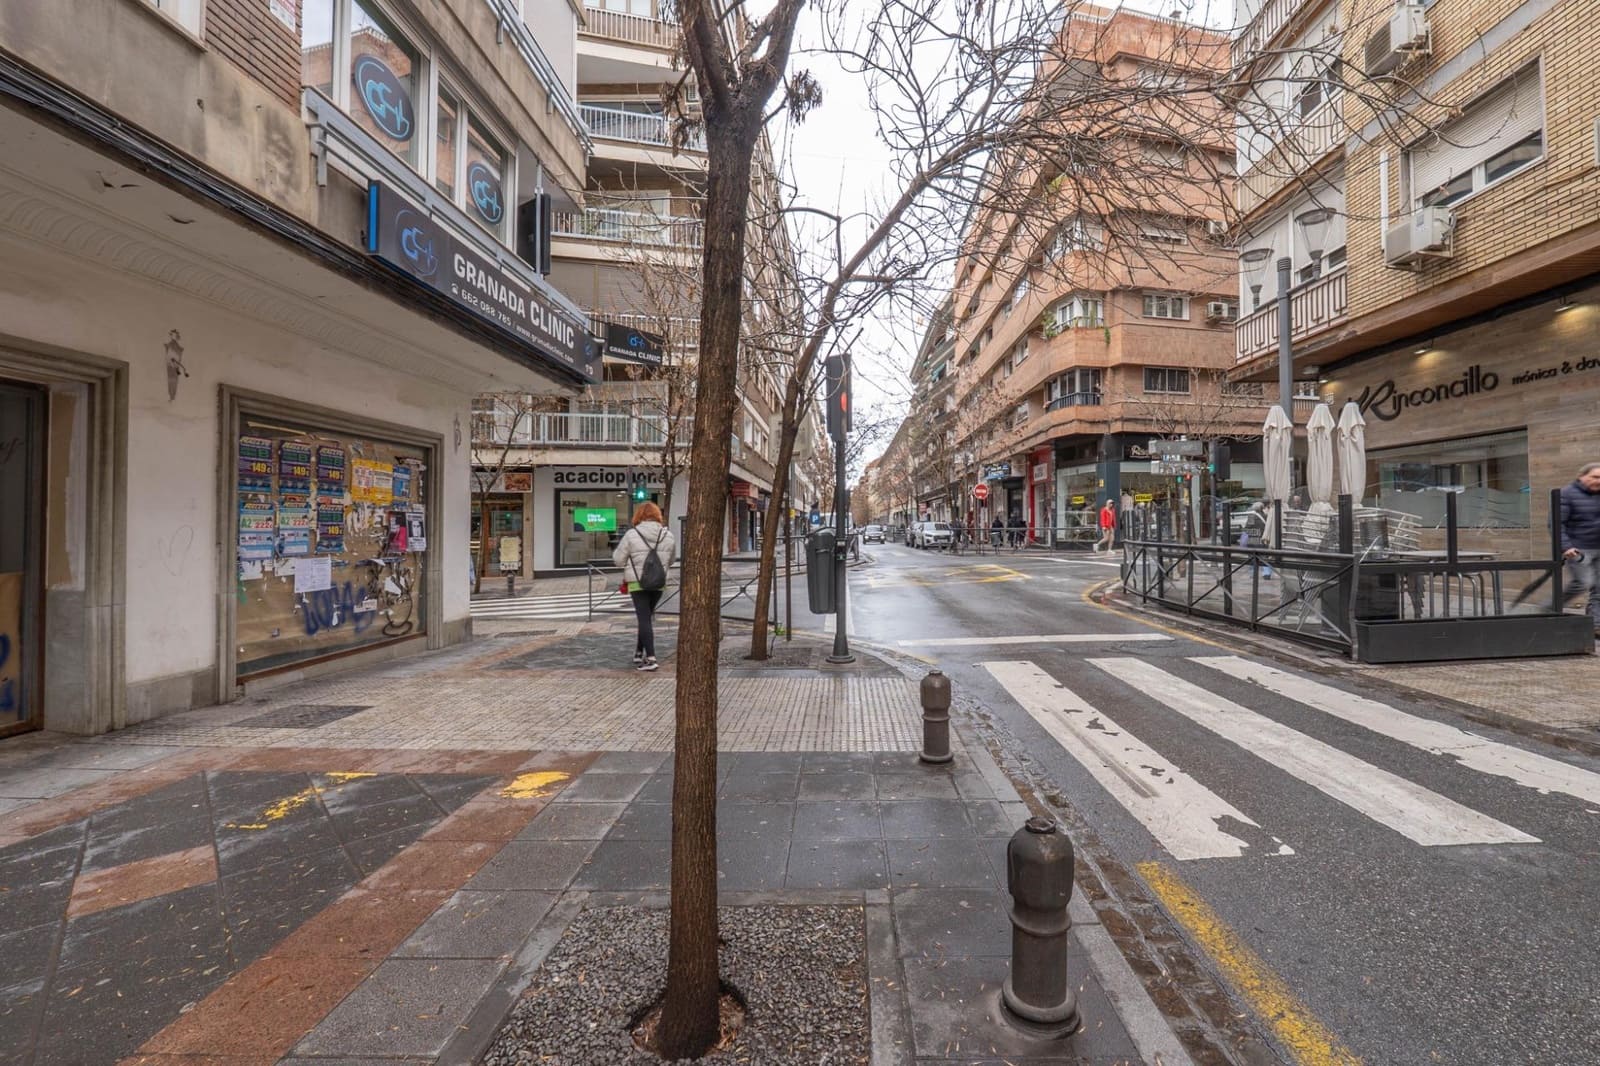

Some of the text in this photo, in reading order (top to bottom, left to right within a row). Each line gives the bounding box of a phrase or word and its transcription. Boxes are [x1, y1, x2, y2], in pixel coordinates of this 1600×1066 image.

[454, 253, 575, 349] GRANADA CLINIC
[461, 289, 478, 306] 662
[498, 311, 512, 326] 785
[609, 346, 661, 362] GRANADA CLINIC
[1512, 366, 1558, 385] mónica
[1560, 361, 1574, 375] &
[812, 514, 819, 523] P
